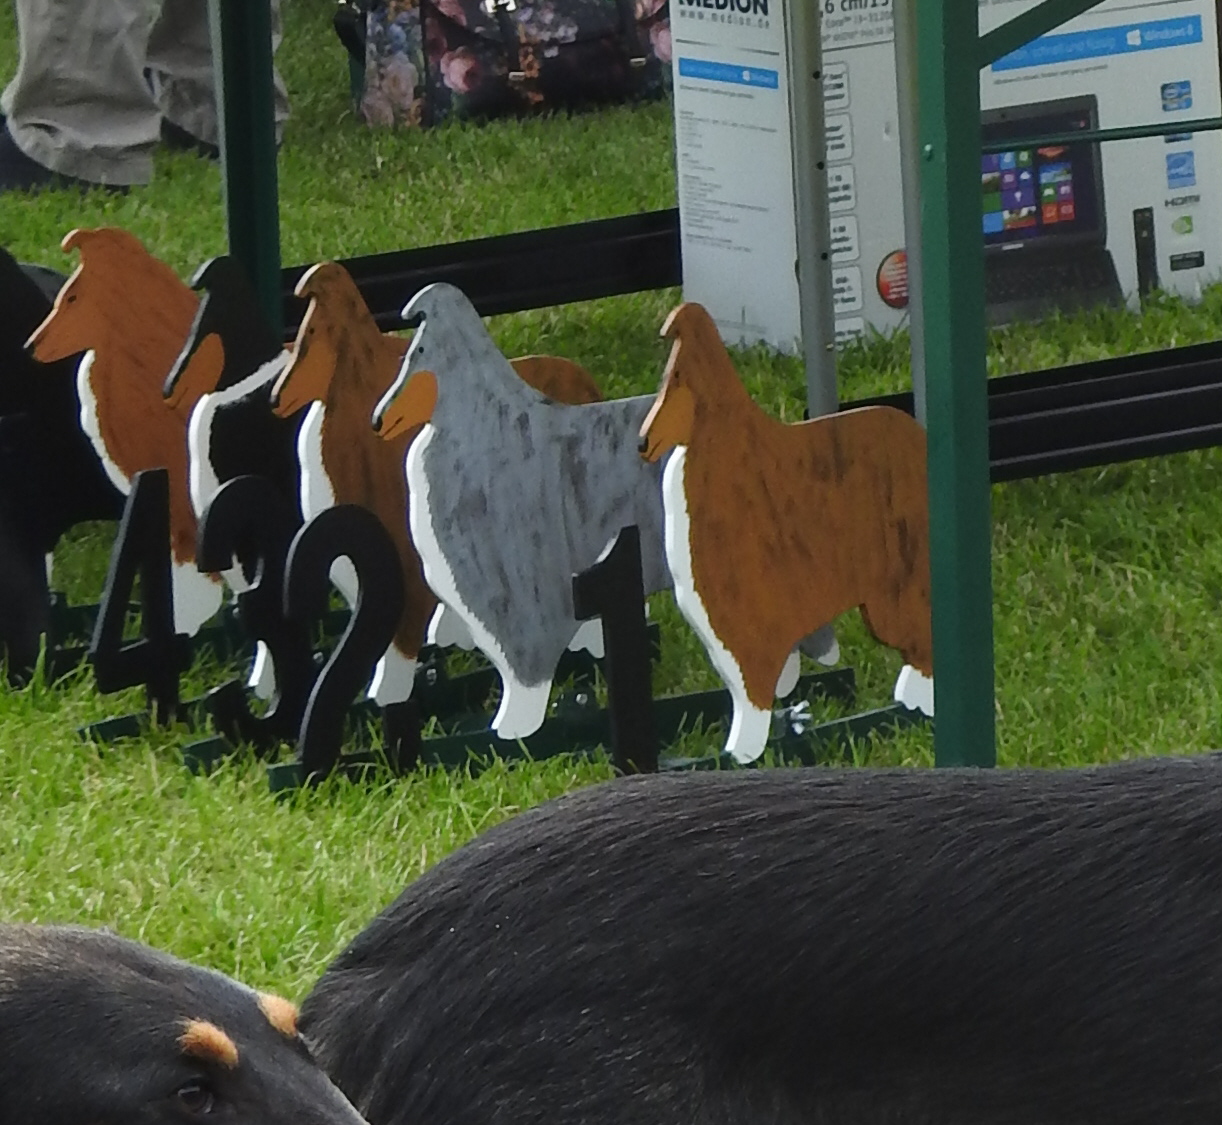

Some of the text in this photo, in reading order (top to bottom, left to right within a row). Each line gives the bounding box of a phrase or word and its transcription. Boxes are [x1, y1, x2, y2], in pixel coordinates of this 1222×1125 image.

[1164, 194, 1201, 208] HDMI
[89, 466, 192, 726] 4
[282, 503, 404, 785] 2
[573, 524, 658, 776] 1
